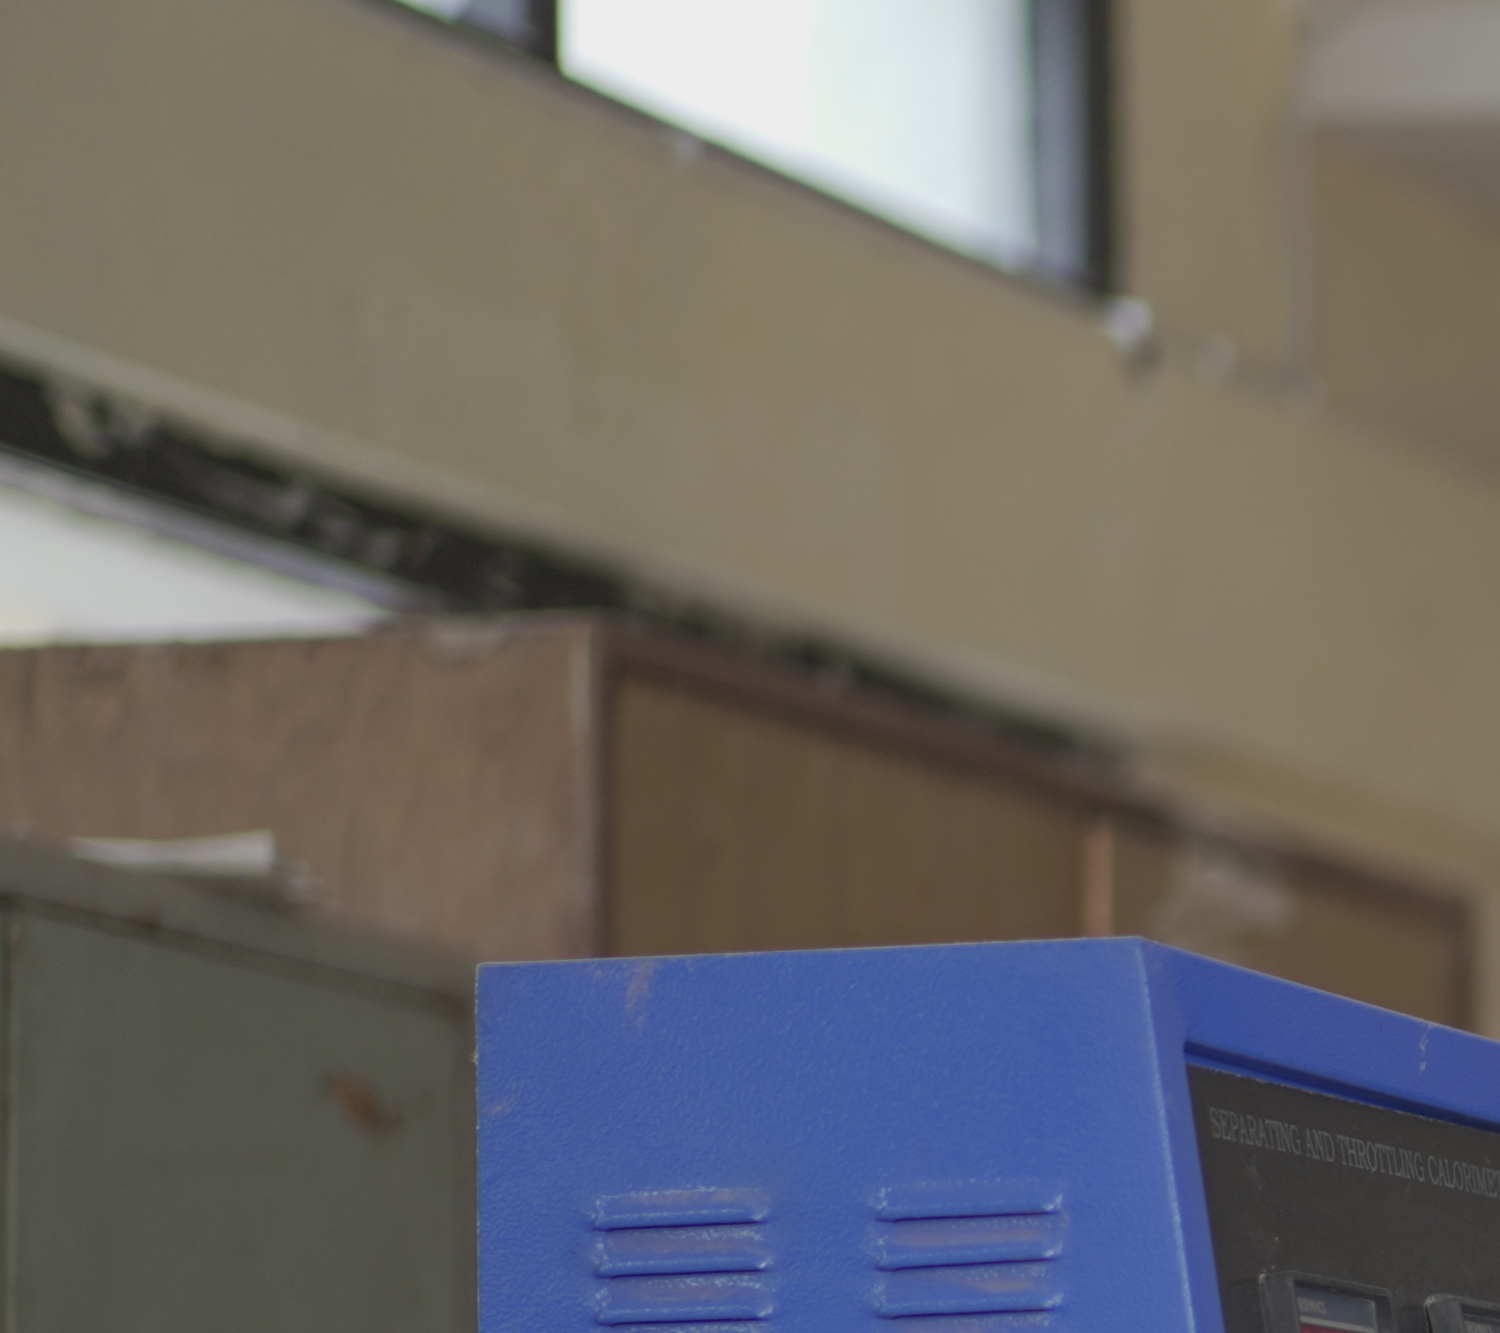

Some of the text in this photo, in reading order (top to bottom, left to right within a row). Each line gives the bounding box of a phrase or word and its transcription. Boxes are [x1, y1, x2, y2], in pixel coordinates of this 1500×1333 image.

[1209, 1106, 1302, 1156] SEPARATING
[1306, 1127, 1336, 1163] AND
[1336, 1133, 1426, 1183] THROTTLING
